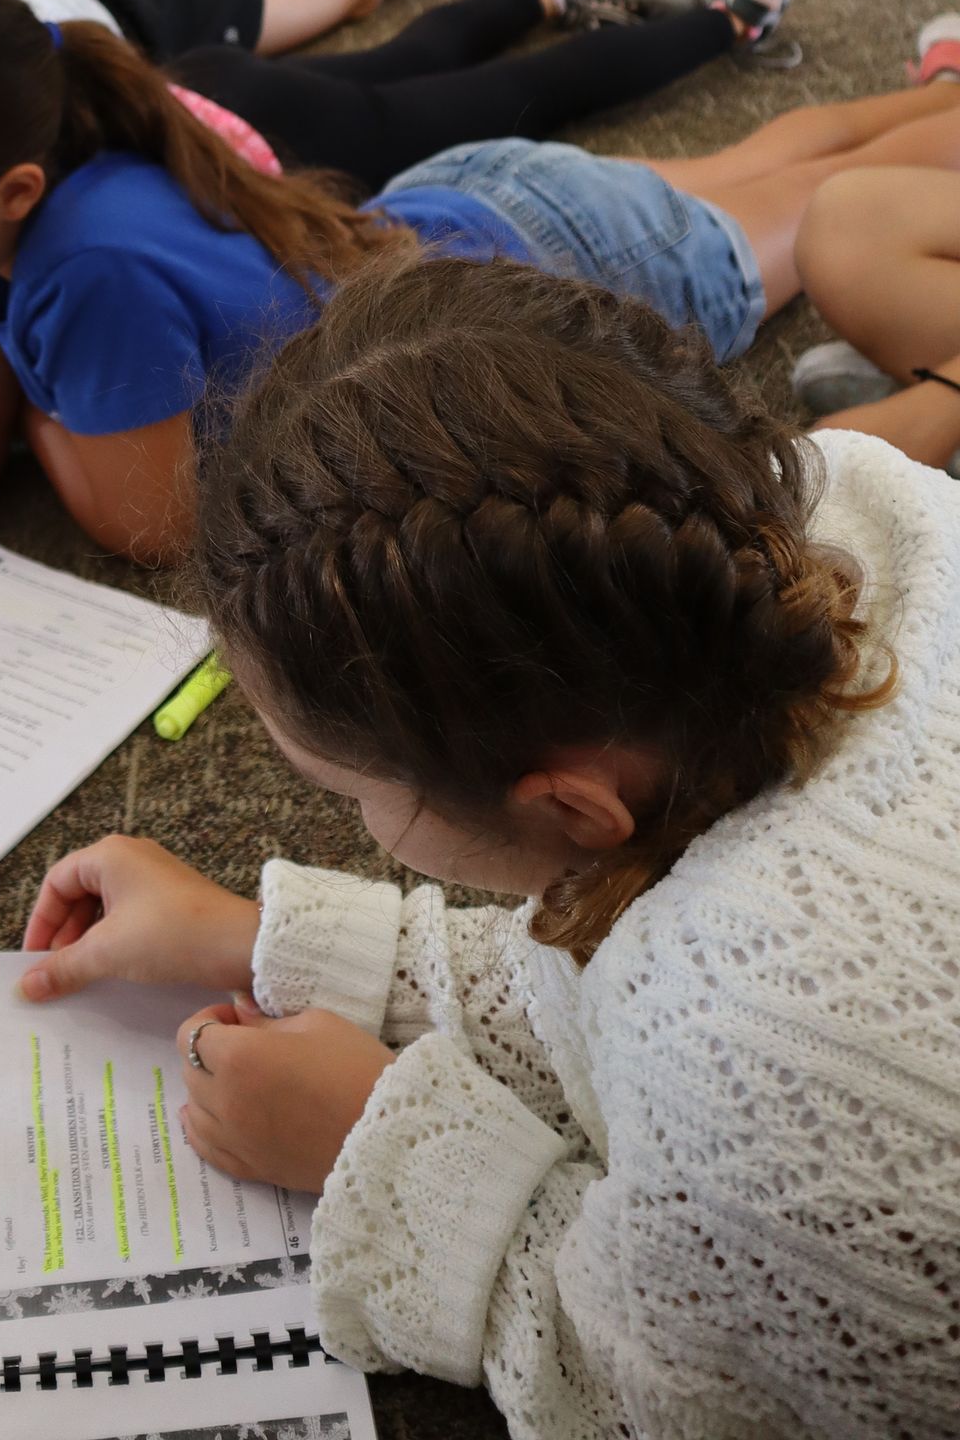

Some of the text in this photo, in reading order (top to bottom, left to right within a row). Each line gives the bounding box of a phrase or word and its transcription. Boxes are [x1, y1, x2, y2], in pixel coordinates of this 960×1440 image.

[26, 1125, 37, 1164] KRISTOFF
[98, 1114, 111, 1169] STORYTELLER
[150, 1111, 162, 1164] STORYTELLER
